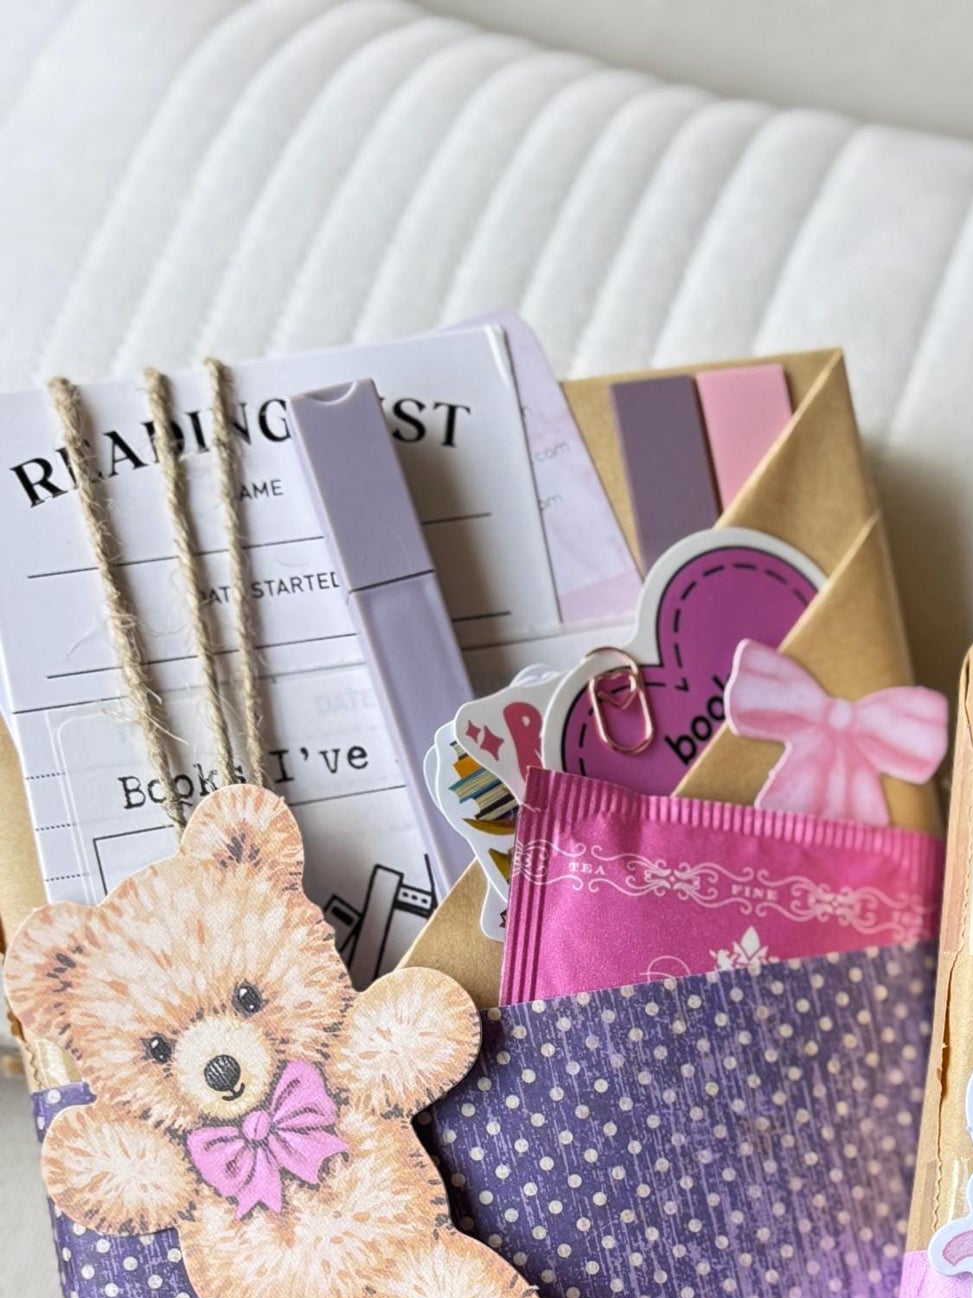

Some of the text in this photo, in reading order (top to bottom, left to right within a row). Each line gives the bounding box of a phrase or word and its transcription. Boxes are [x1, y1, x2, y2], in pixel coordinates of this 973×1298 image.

[381, 396, 471, 448] ST
[240, 479, 284, 501] AME
[268, 745, 369, 784] I've
[569, 862, 778, 901] TEA FINE
